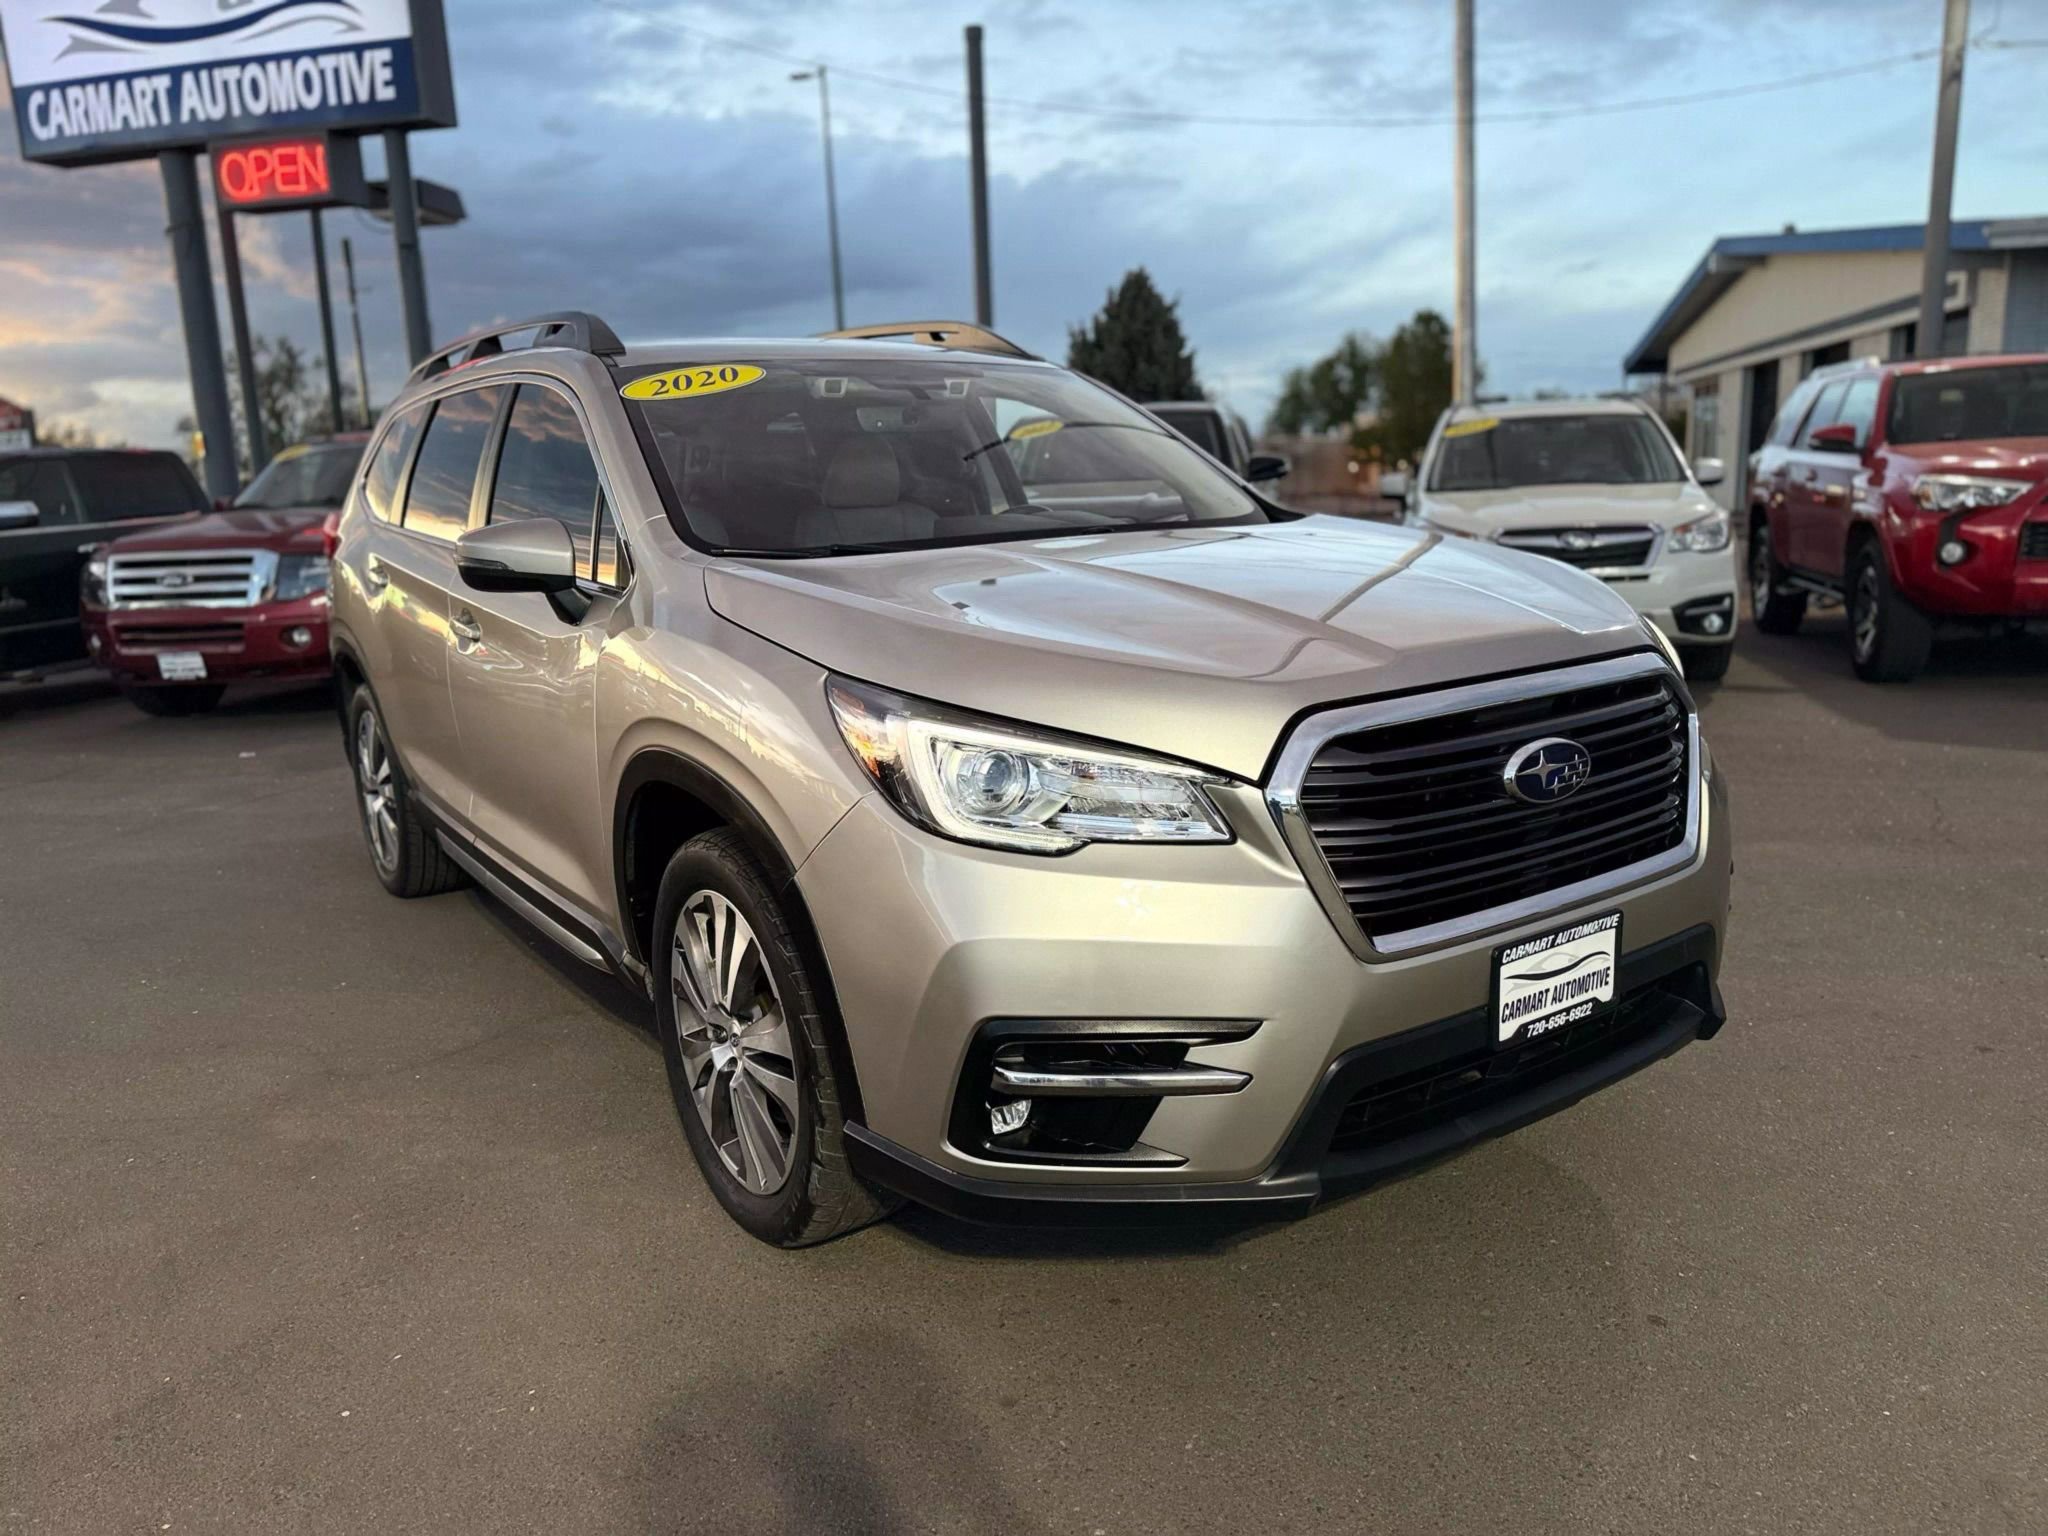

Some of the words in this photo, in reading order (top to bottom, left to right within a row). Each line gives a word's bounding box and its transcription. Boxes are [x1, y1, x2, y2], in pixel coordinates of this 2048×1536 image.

[28, 73, 172, 141] CARMART
[180, 48, 396, 123] AUTOMOTIVE
[219, 143, 329, 203] OPEN
[649, 367, 739, 396] 2020
[1502, 935, 1555, 964] CARMART
[1555, 914, 1620, 945] AUTOMOTIVE
[1502, 988, 1550, 1023] CARMART
[1551, 967, 1611, 1005] AUTOMOTIVE
